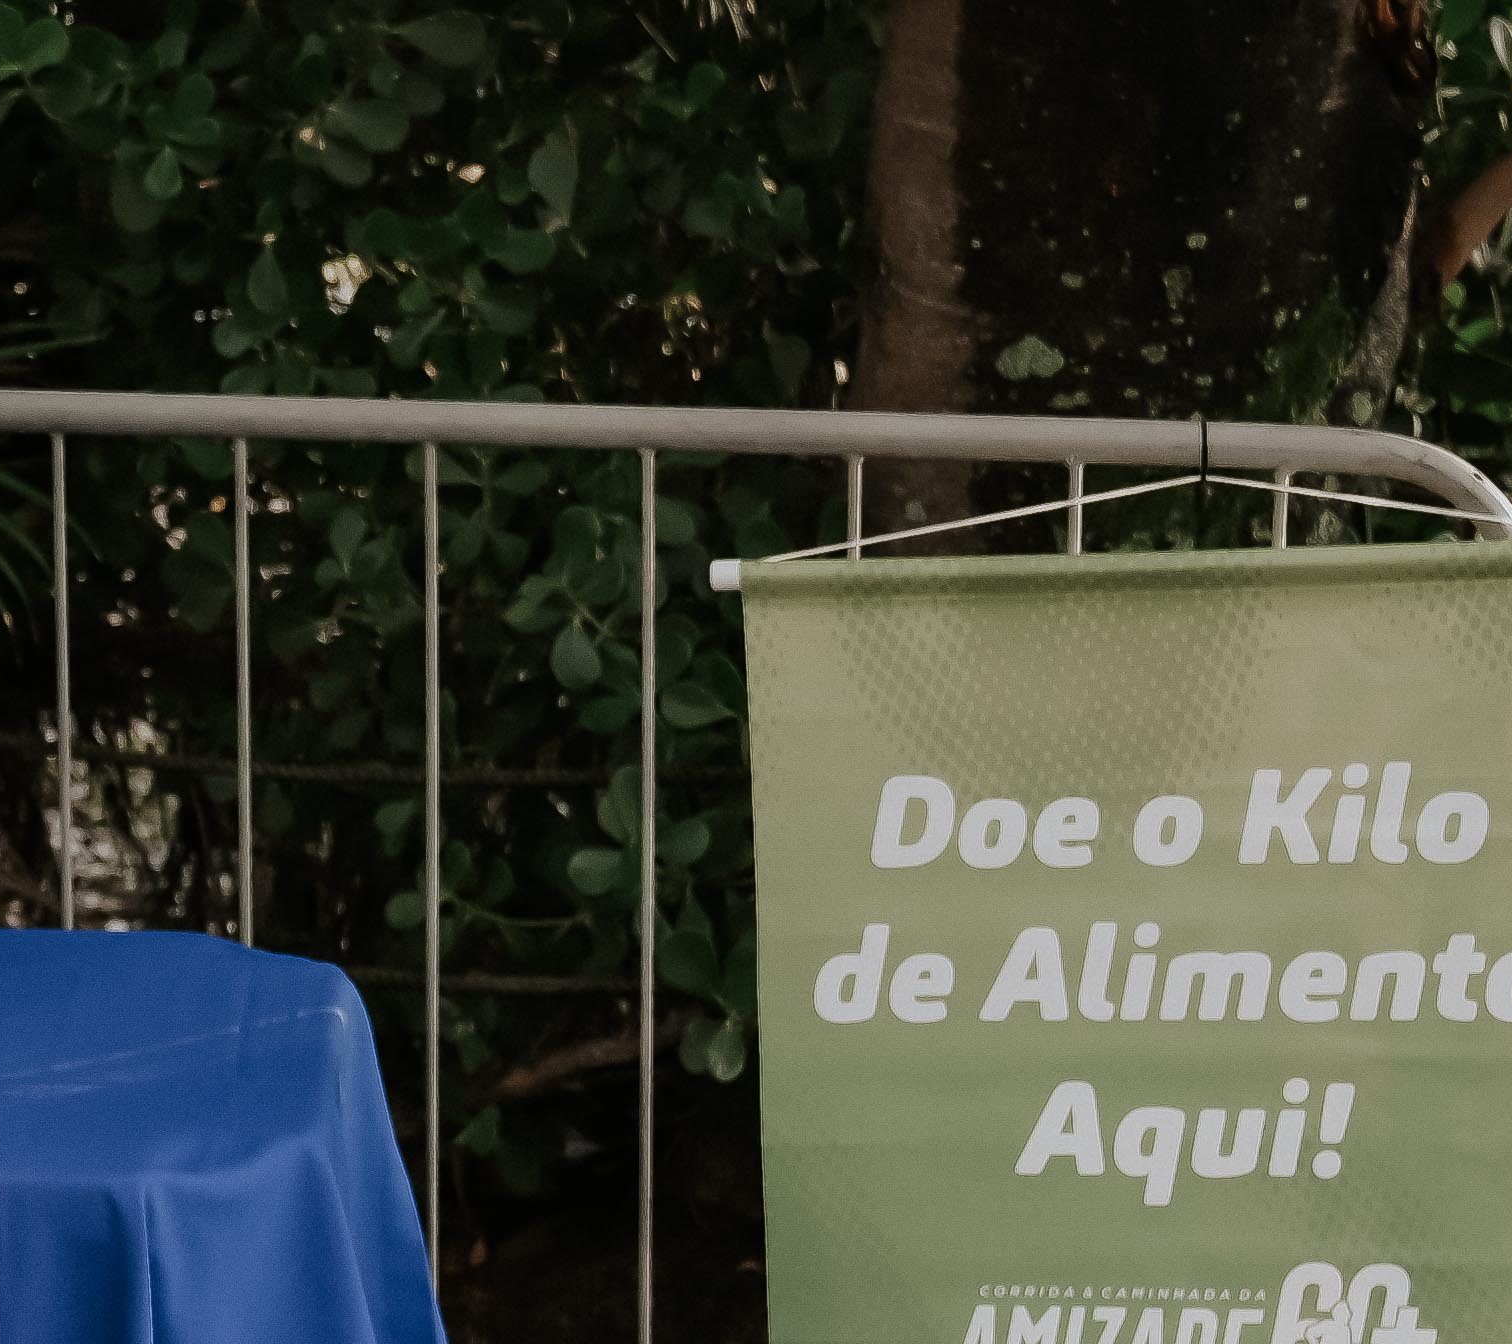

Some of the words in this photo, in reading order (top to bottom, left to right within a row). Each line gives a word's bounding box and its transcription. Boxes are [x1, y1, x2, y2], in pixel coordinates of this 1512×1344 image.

[870, 774, 1101, 869] Doe
[1132, 794, 1204, 868] o
[1237, 761, 1491, 866] Kilo
[812, 922, 955, 1025] de
[1014, 1077, 1357, 1207] Aqui!
[978, 1284, 1075, 1299] CORRIDA
[1101, 1286, 1232, 1302] CAMINHADA
[1237, 1287, 1267, 1302] DA
